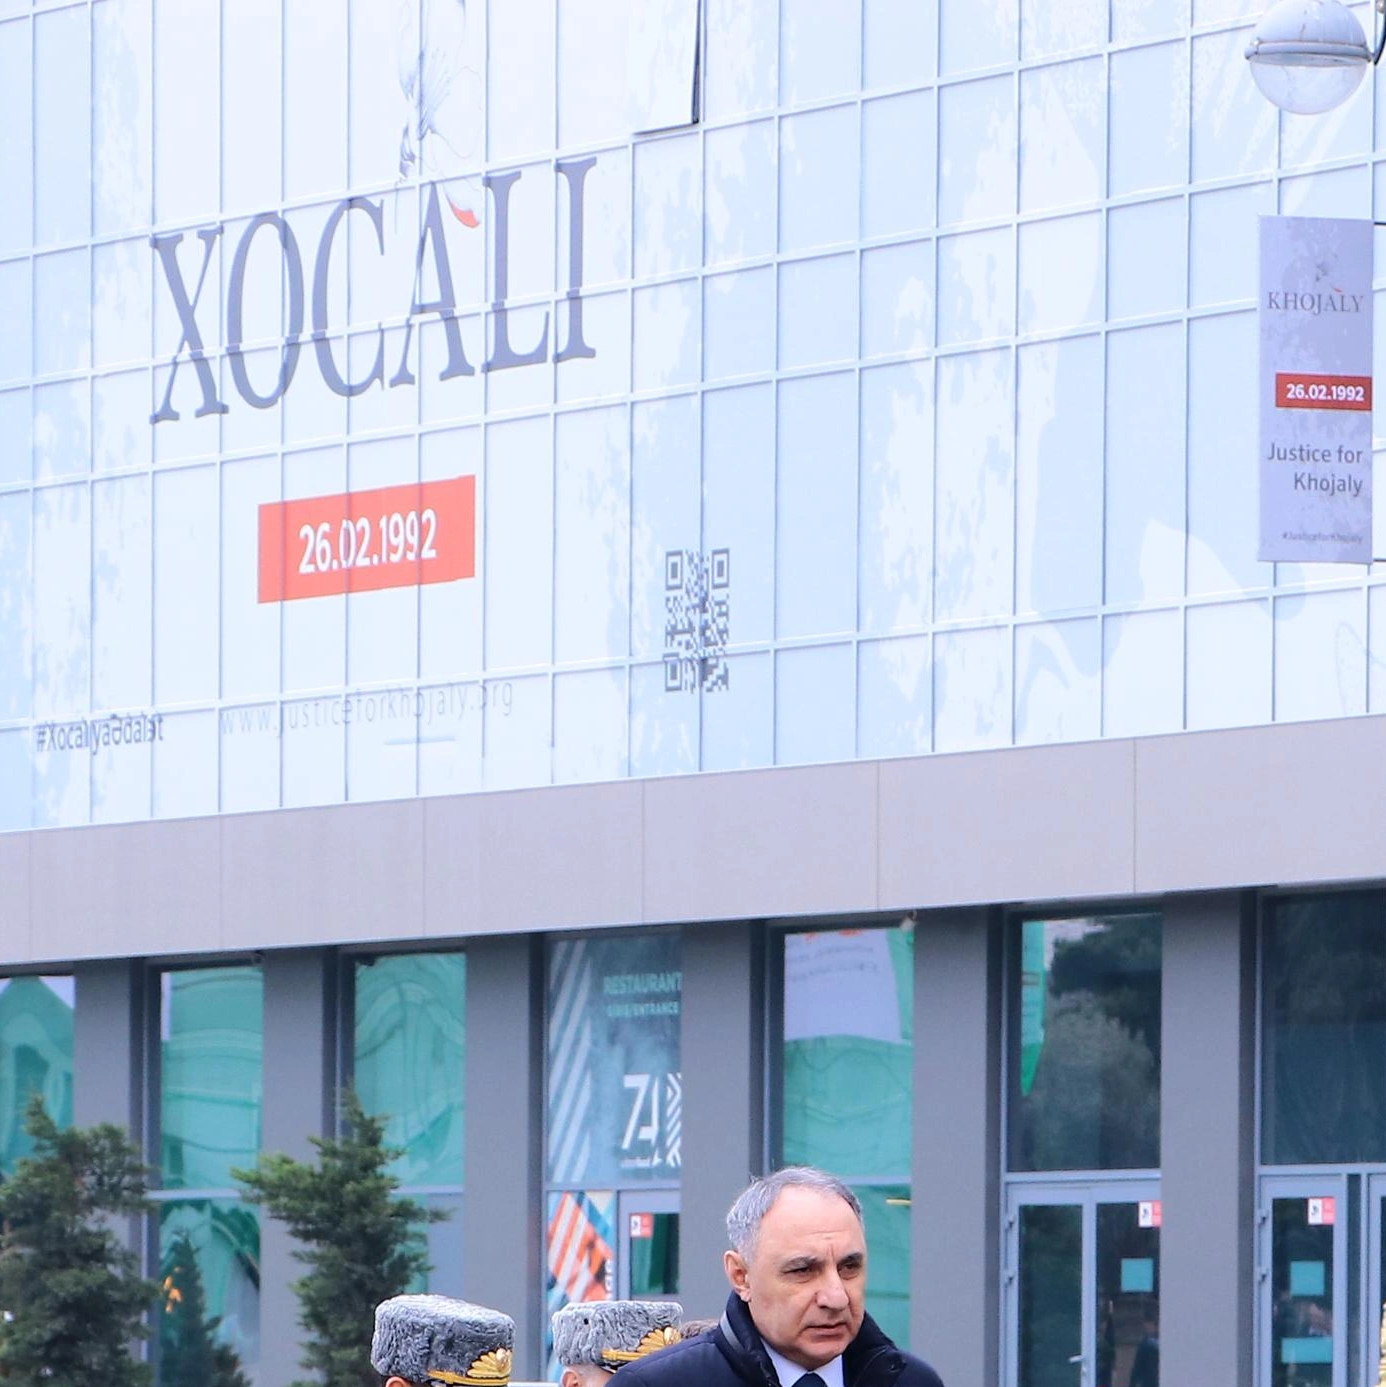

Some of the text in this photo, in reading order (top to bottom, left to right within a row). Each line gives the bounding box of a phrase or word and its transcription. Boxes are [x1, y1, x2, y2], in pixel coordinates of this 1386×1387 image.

[150, 157, 597, 424] XOCALI
[1268, 292, 1364, 315] KHOJALY
[1286, 383, 1364, 401] 26.02.1992
[1267, 442, 1363, 463] Justice for
[1294, 472, 1363, 497] Khojaly
[299, 508, 436, 574] 26.02.1992
